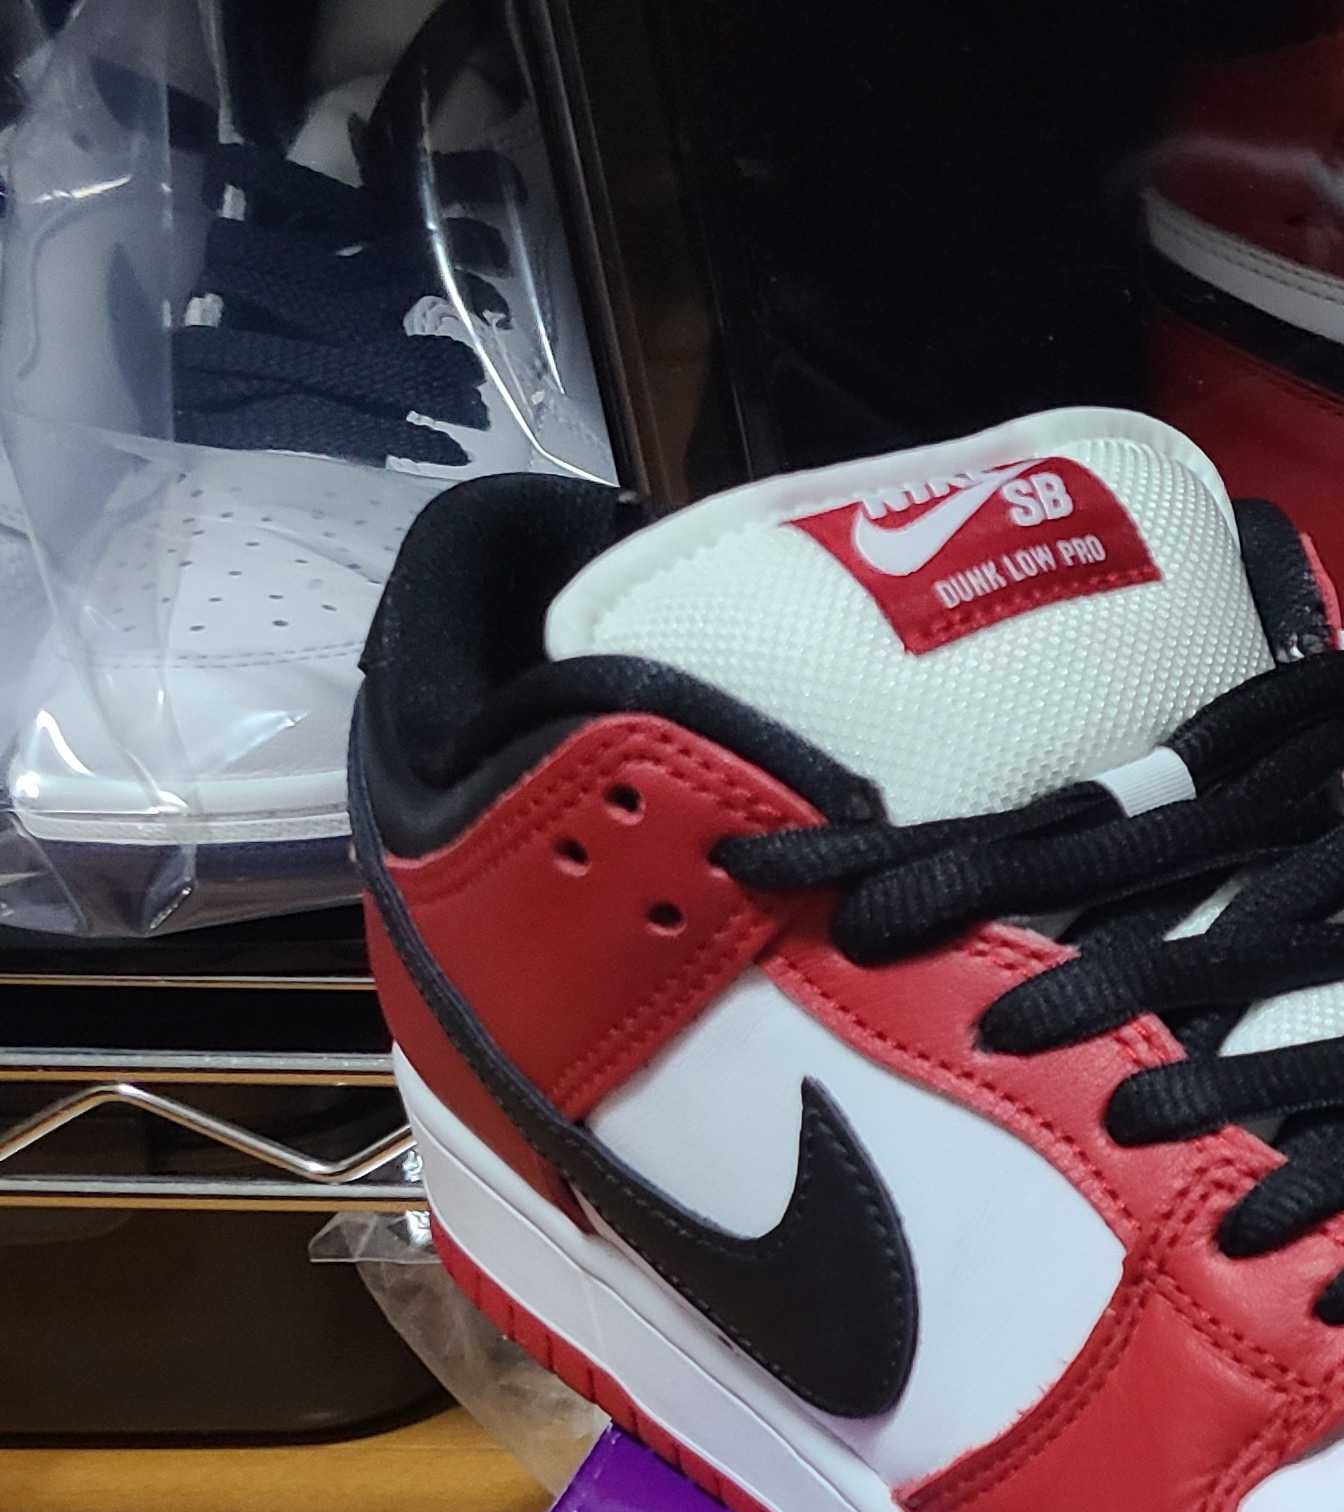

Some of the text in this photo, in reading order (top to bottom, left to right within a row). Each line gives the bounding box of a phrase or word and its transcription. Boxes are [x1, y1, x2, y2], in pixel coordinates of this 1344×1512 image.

[1001, 471, 1074, 527] SB
[934, 534, 1107, 609] DUNK LOW PRO
